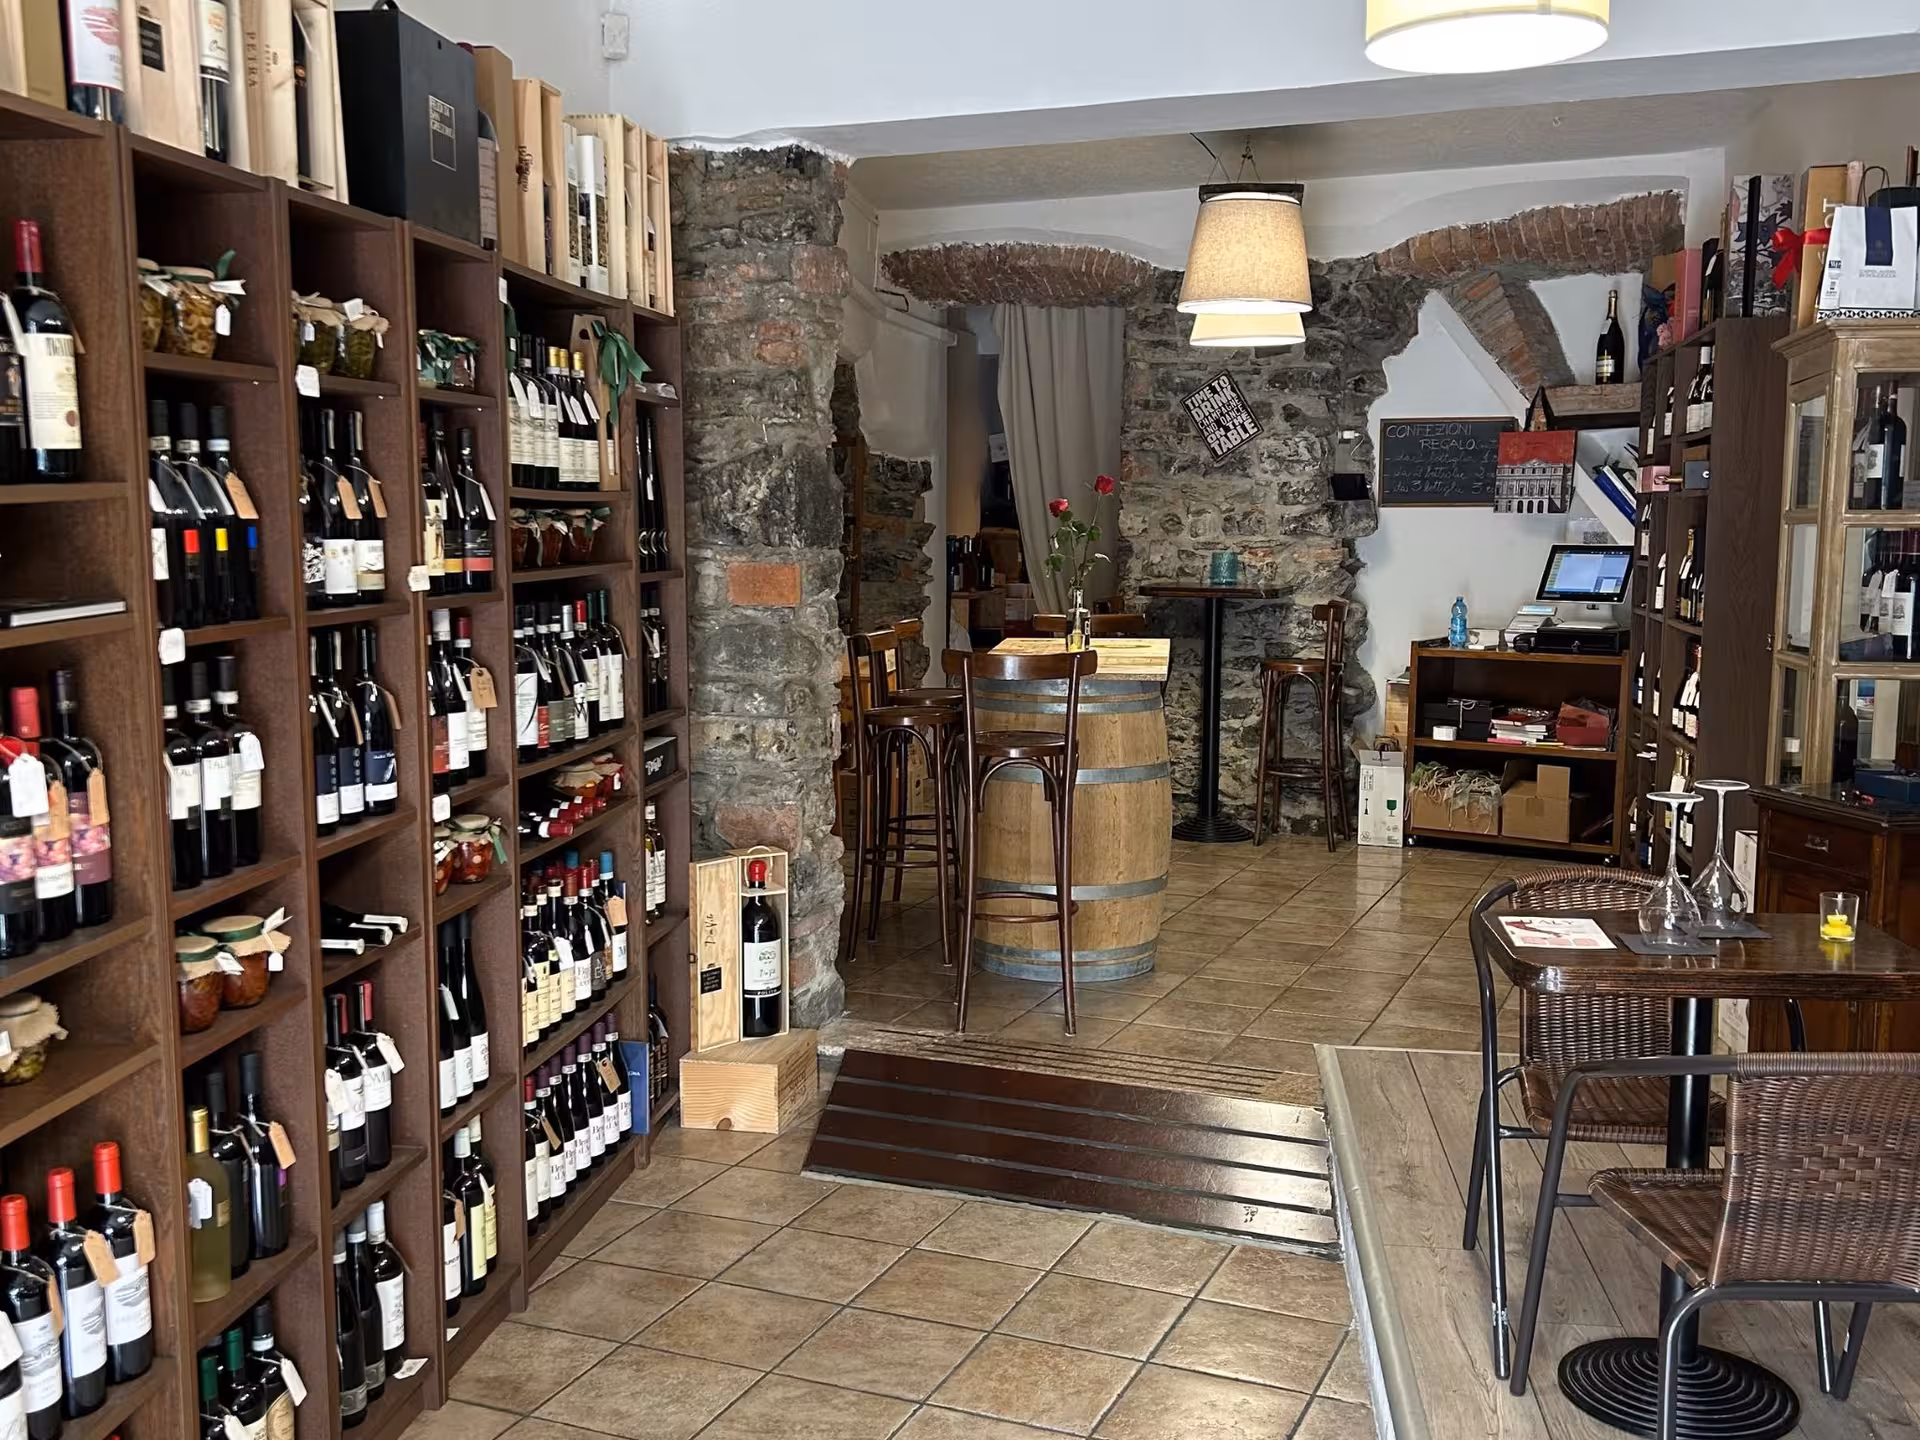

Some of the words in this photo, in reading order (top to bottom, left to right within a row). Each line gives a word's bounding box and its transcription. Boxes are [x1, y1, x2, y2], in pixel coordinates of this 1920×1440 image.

[1185, 387, 1213, 410] TIME
[1212, 375, 1230, 392] TO
[1191, 385, 1237, 422] DRINK
[1197, 396, 1242, 430] CHAMPAGNE
[1203, 422, 1218, 437] AND
[1219, 404, 1244, 426] DANCE
[1206, 427, 1226, 444] ON
[1225, 411, 1249, 430] THE
[1210, 419, 1258, 456] TABLE
[1386, 422, 1472, 438] CONFEZIONI
[1419, 438, 1476, 451] REGALO
